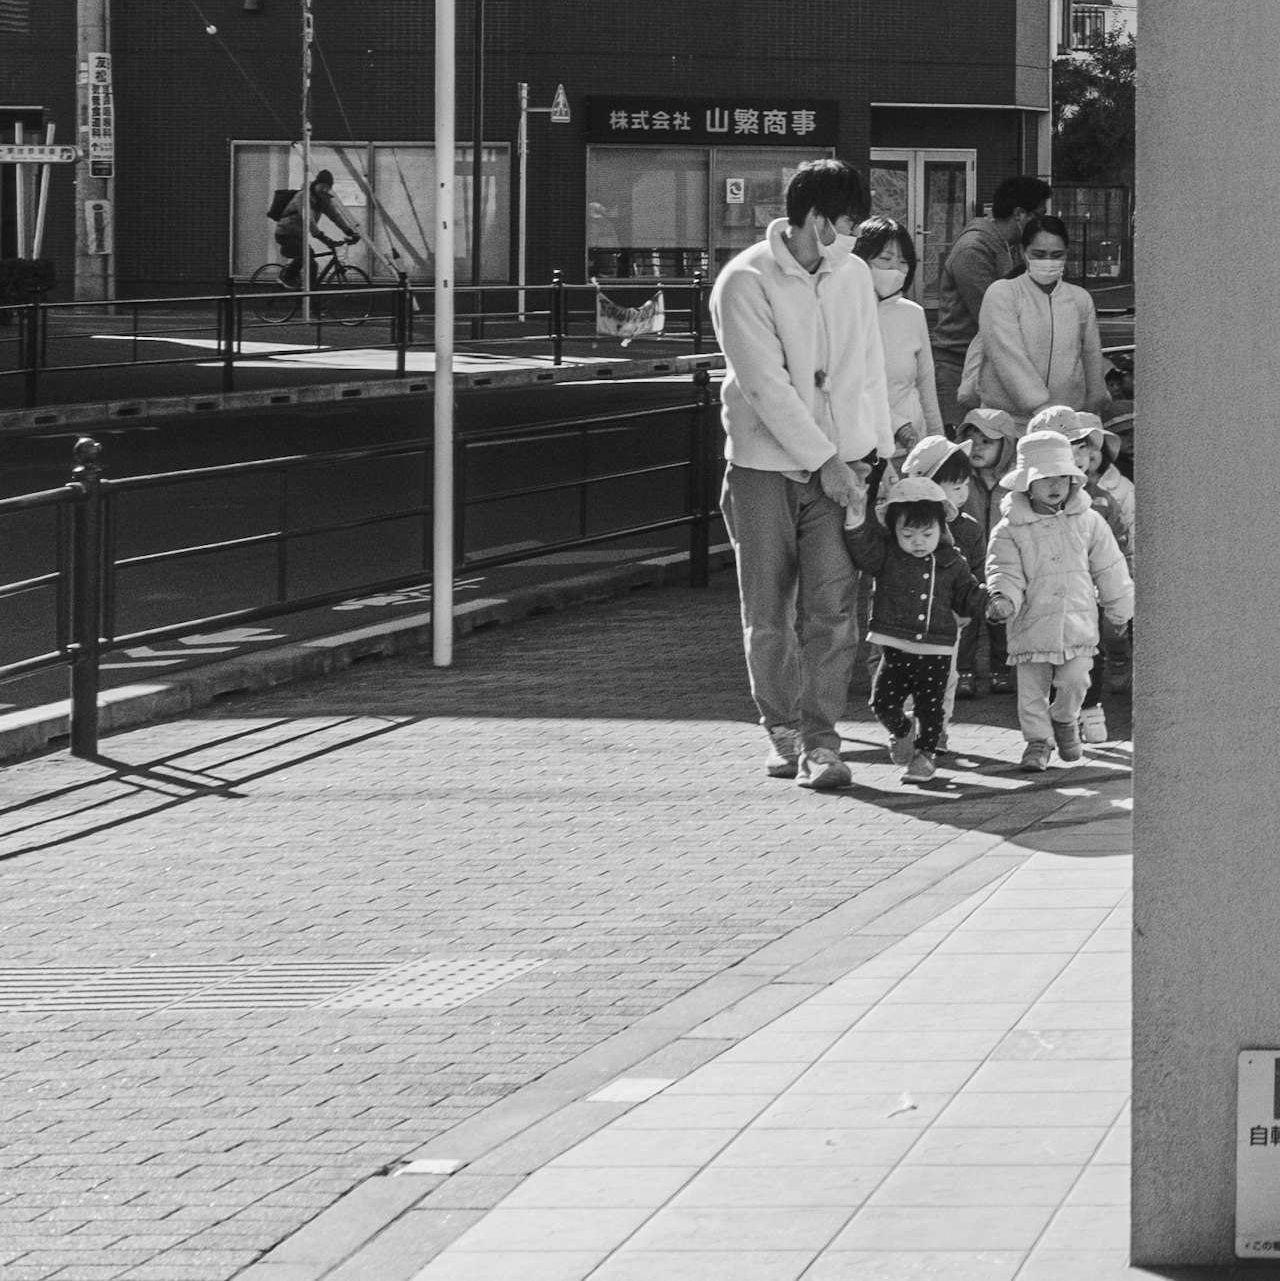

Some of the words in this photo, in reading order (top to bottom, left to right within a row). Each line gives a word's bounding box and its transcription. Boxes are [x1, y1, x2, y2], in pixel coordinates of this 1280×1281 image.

[610, 110, 690, 130] 株式会社
[706, 107, 816, 135] 山繁商事
